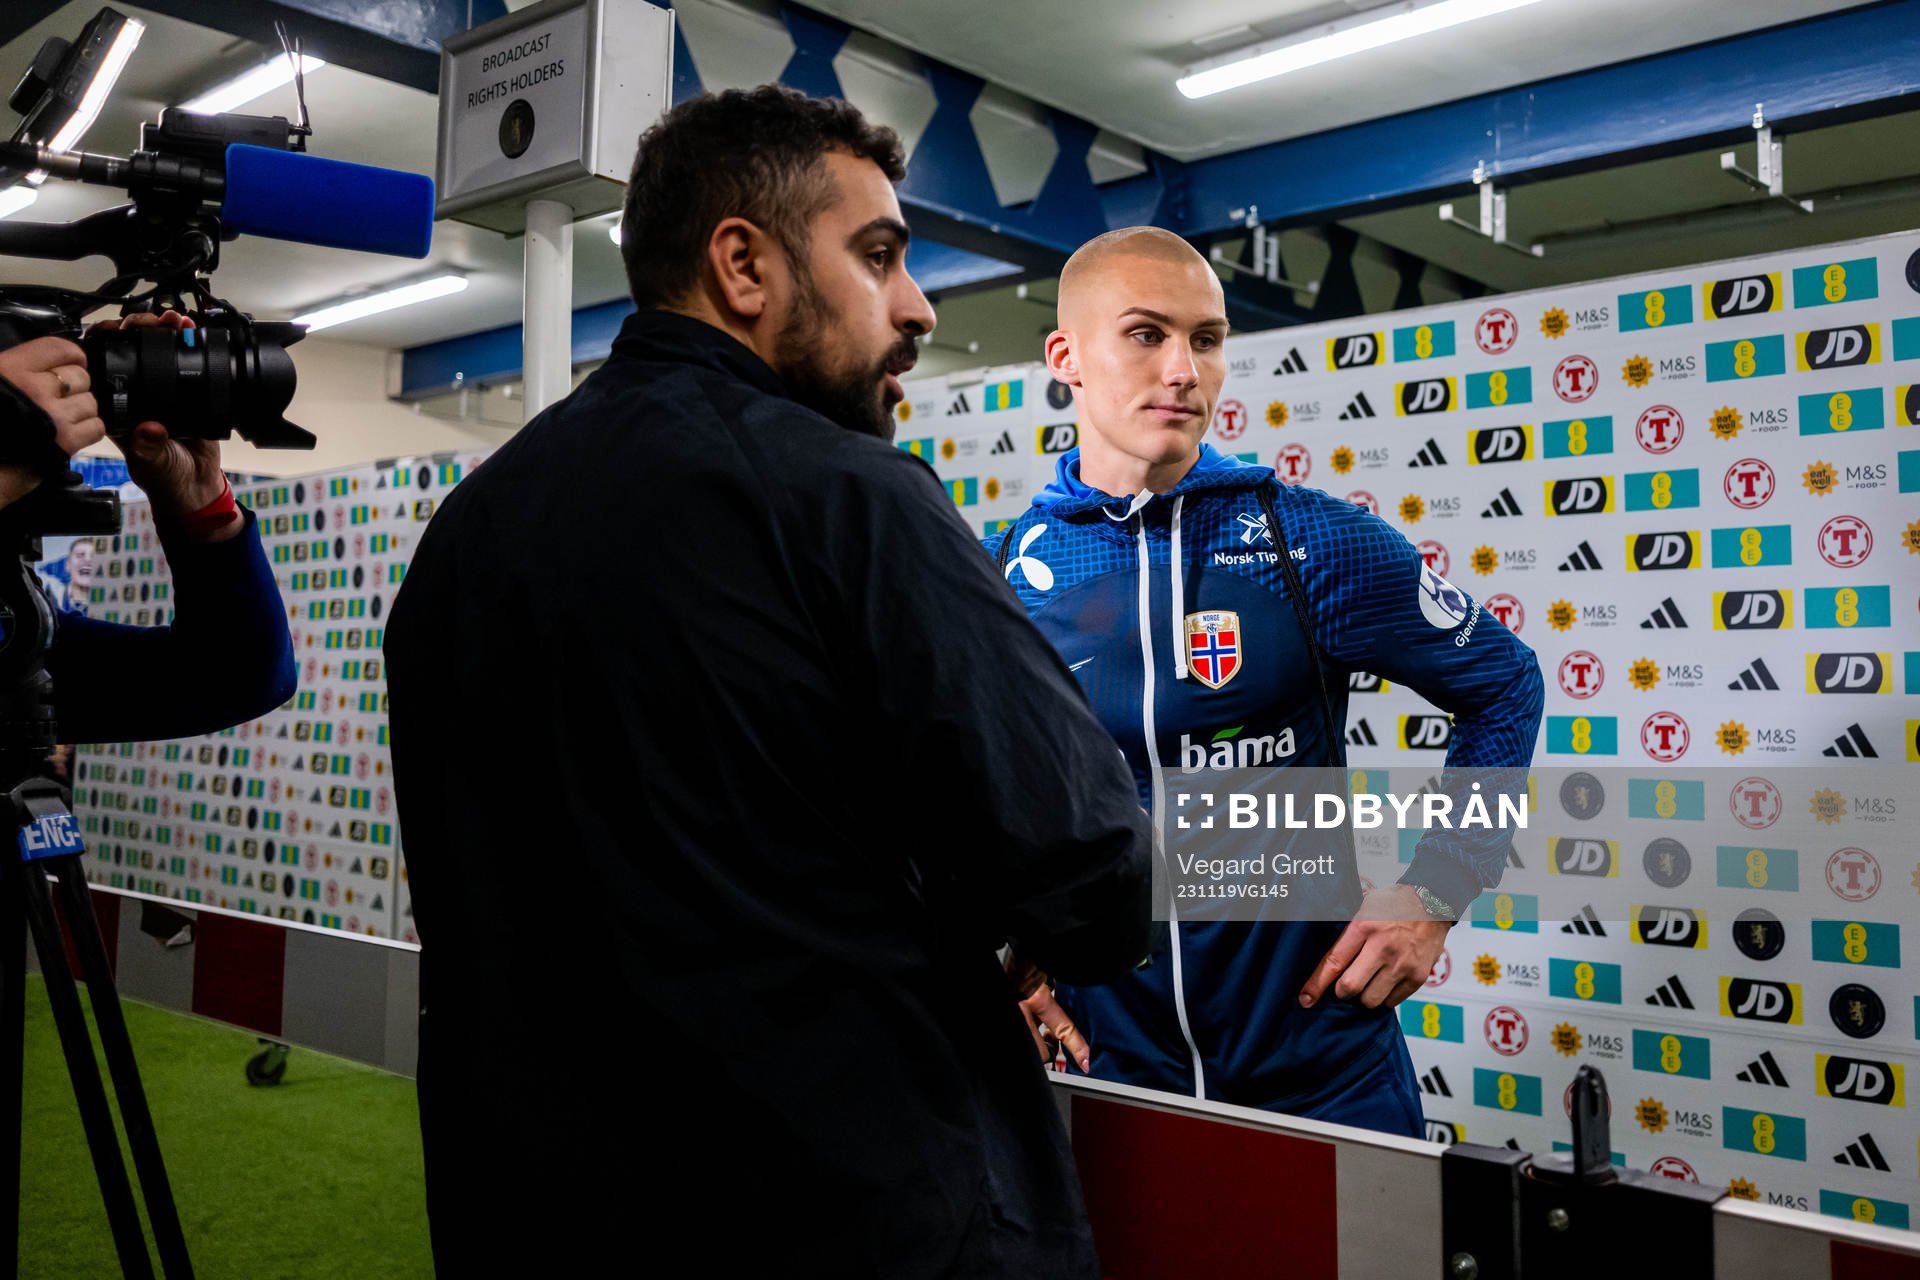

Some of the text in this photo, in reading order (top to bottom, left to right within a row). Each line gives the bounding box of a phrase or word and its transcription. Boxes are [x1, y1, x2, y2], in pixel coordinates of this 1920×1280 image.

[482, 33, 552, 73] BROADCAST
[468, 60, 565, 109] RIGHTS HOLDERS
[1721, 279, 1766, 313] JD
[1576, 307, 1608, 324] M&S
[1488, 320, 1505, 344] T
[1338, 336, 1374, 366] JD
[1815, 329, 1862, 364] JD
[1660, 356, 1695, 374] M&S
[1566, 368, 1586, 393] T
[1408, 381, 1445, 411] JD
[1223, 410, 1237, 431] T
[1750, 408, 1787, 425] M&S
[1046, 425, 1075, 451] JD
[1649, 417, 1671, 444] T
[1482, 430, 1521, 461] JD
[1285, 455, 1301, 477] T
[1846, 464, 1887, 481] M&S
[1560, 480, 1600, 512] JD
[1738, 471, 1761, 498] T
[1430, 497, 1461, 511] M&S
[1214, 546, 1307, 565] Norsk Tipng
[1643, 535, 1685, 566] JD
[1832, 528, 1858, 557] T
[1505, 550, 1537, 563] M&S
[1202, 614, 1220, 622] NORGE
[1584, 605, 1616, 619] M&S
[1731, 593, 1776, 624] JD
[1571, 663, 1592, 689] T
[1667, 665, 1703, 680] M&S
[1826, 656, 1874, 688] JD
[1412, 717, 1448, 746] JD
[1655, 724, 1677, 751] T
[1757, 729, 1796, 745] M&S
[1180, 727, 1296, 774] bama
[1744, 791, 1767, 818] T
[1855, 798, 1896, 816] M&S
[1563, 841, 1604, 872] JD
[1841, 861, 1866, 890] T
[1647, 908, 1692, 940] JD
[1508, 964, 1540, 981] M&S
[1738, 984, 1784, 1017] JD
[1496, 1019, 1516, 1045] T
[1589, 1034, 1623, 1053] M&S
[1834, 1063, 1884, 1097] JD
[1675, 1110, 1712, 1132] M&S
[1768, 1191, 1808, 1211] M&S
